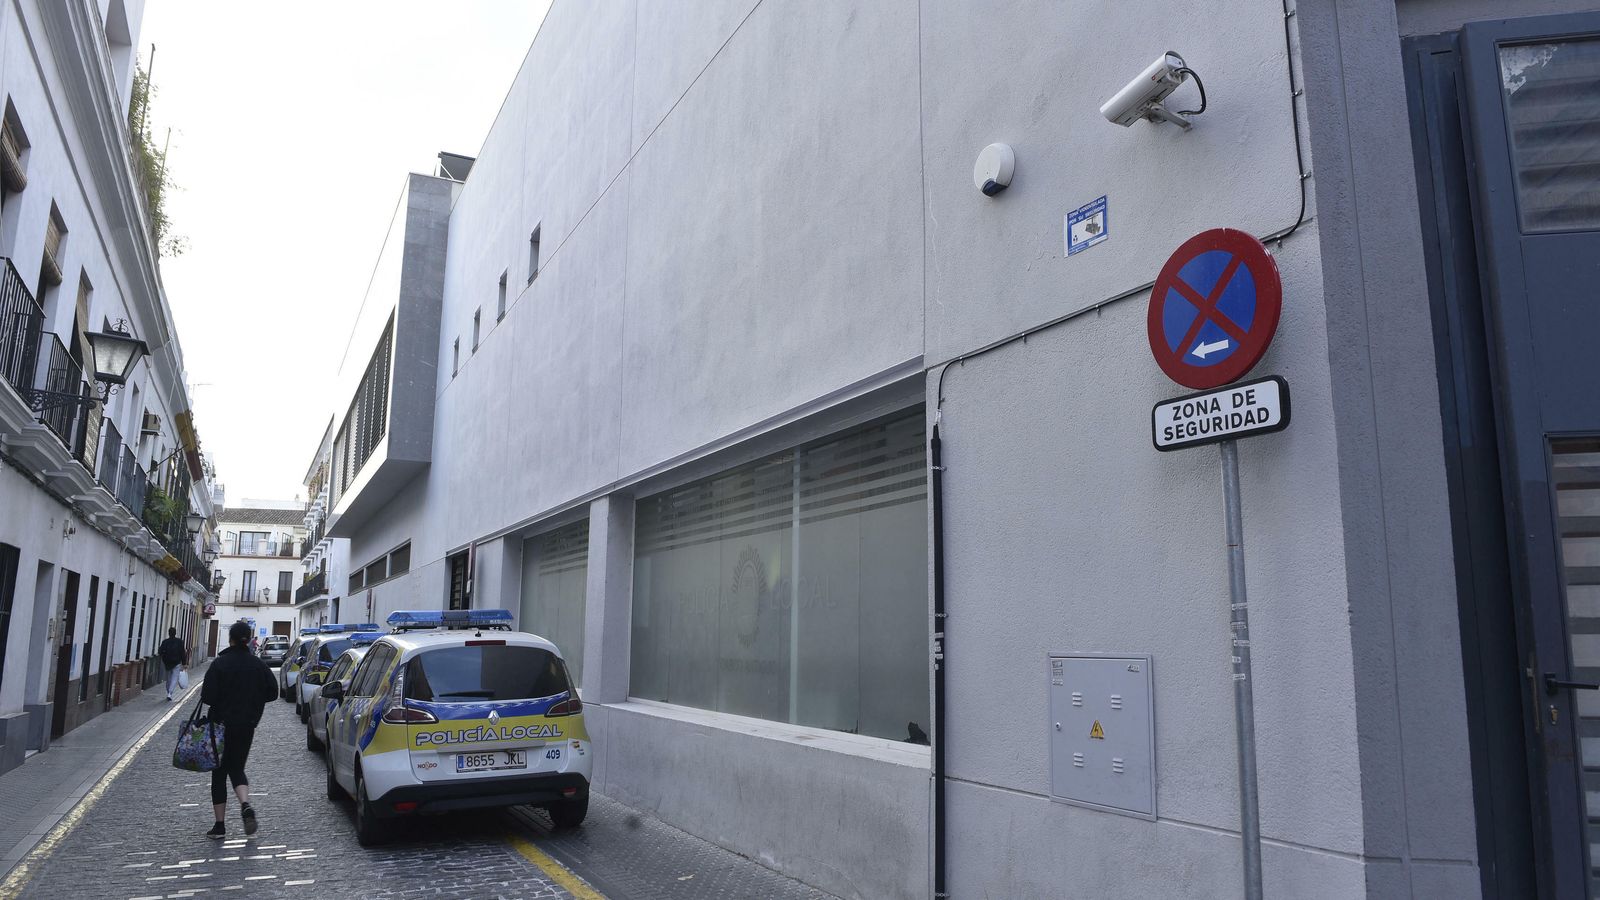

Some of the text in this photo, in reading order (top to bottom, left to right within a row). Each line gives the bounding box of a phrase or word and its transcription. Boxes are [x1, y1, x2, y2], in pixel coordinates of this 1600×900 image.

[1172, 389, 1257, 421] ZONA DE
[1164, 407, 1270, 441] SEGURIDAD
[415, 724, 564, 746] POLICÍA LOCAL
[466, 752, 525, 767] 8655 JKL
[545, 749, 561, 760] 409
